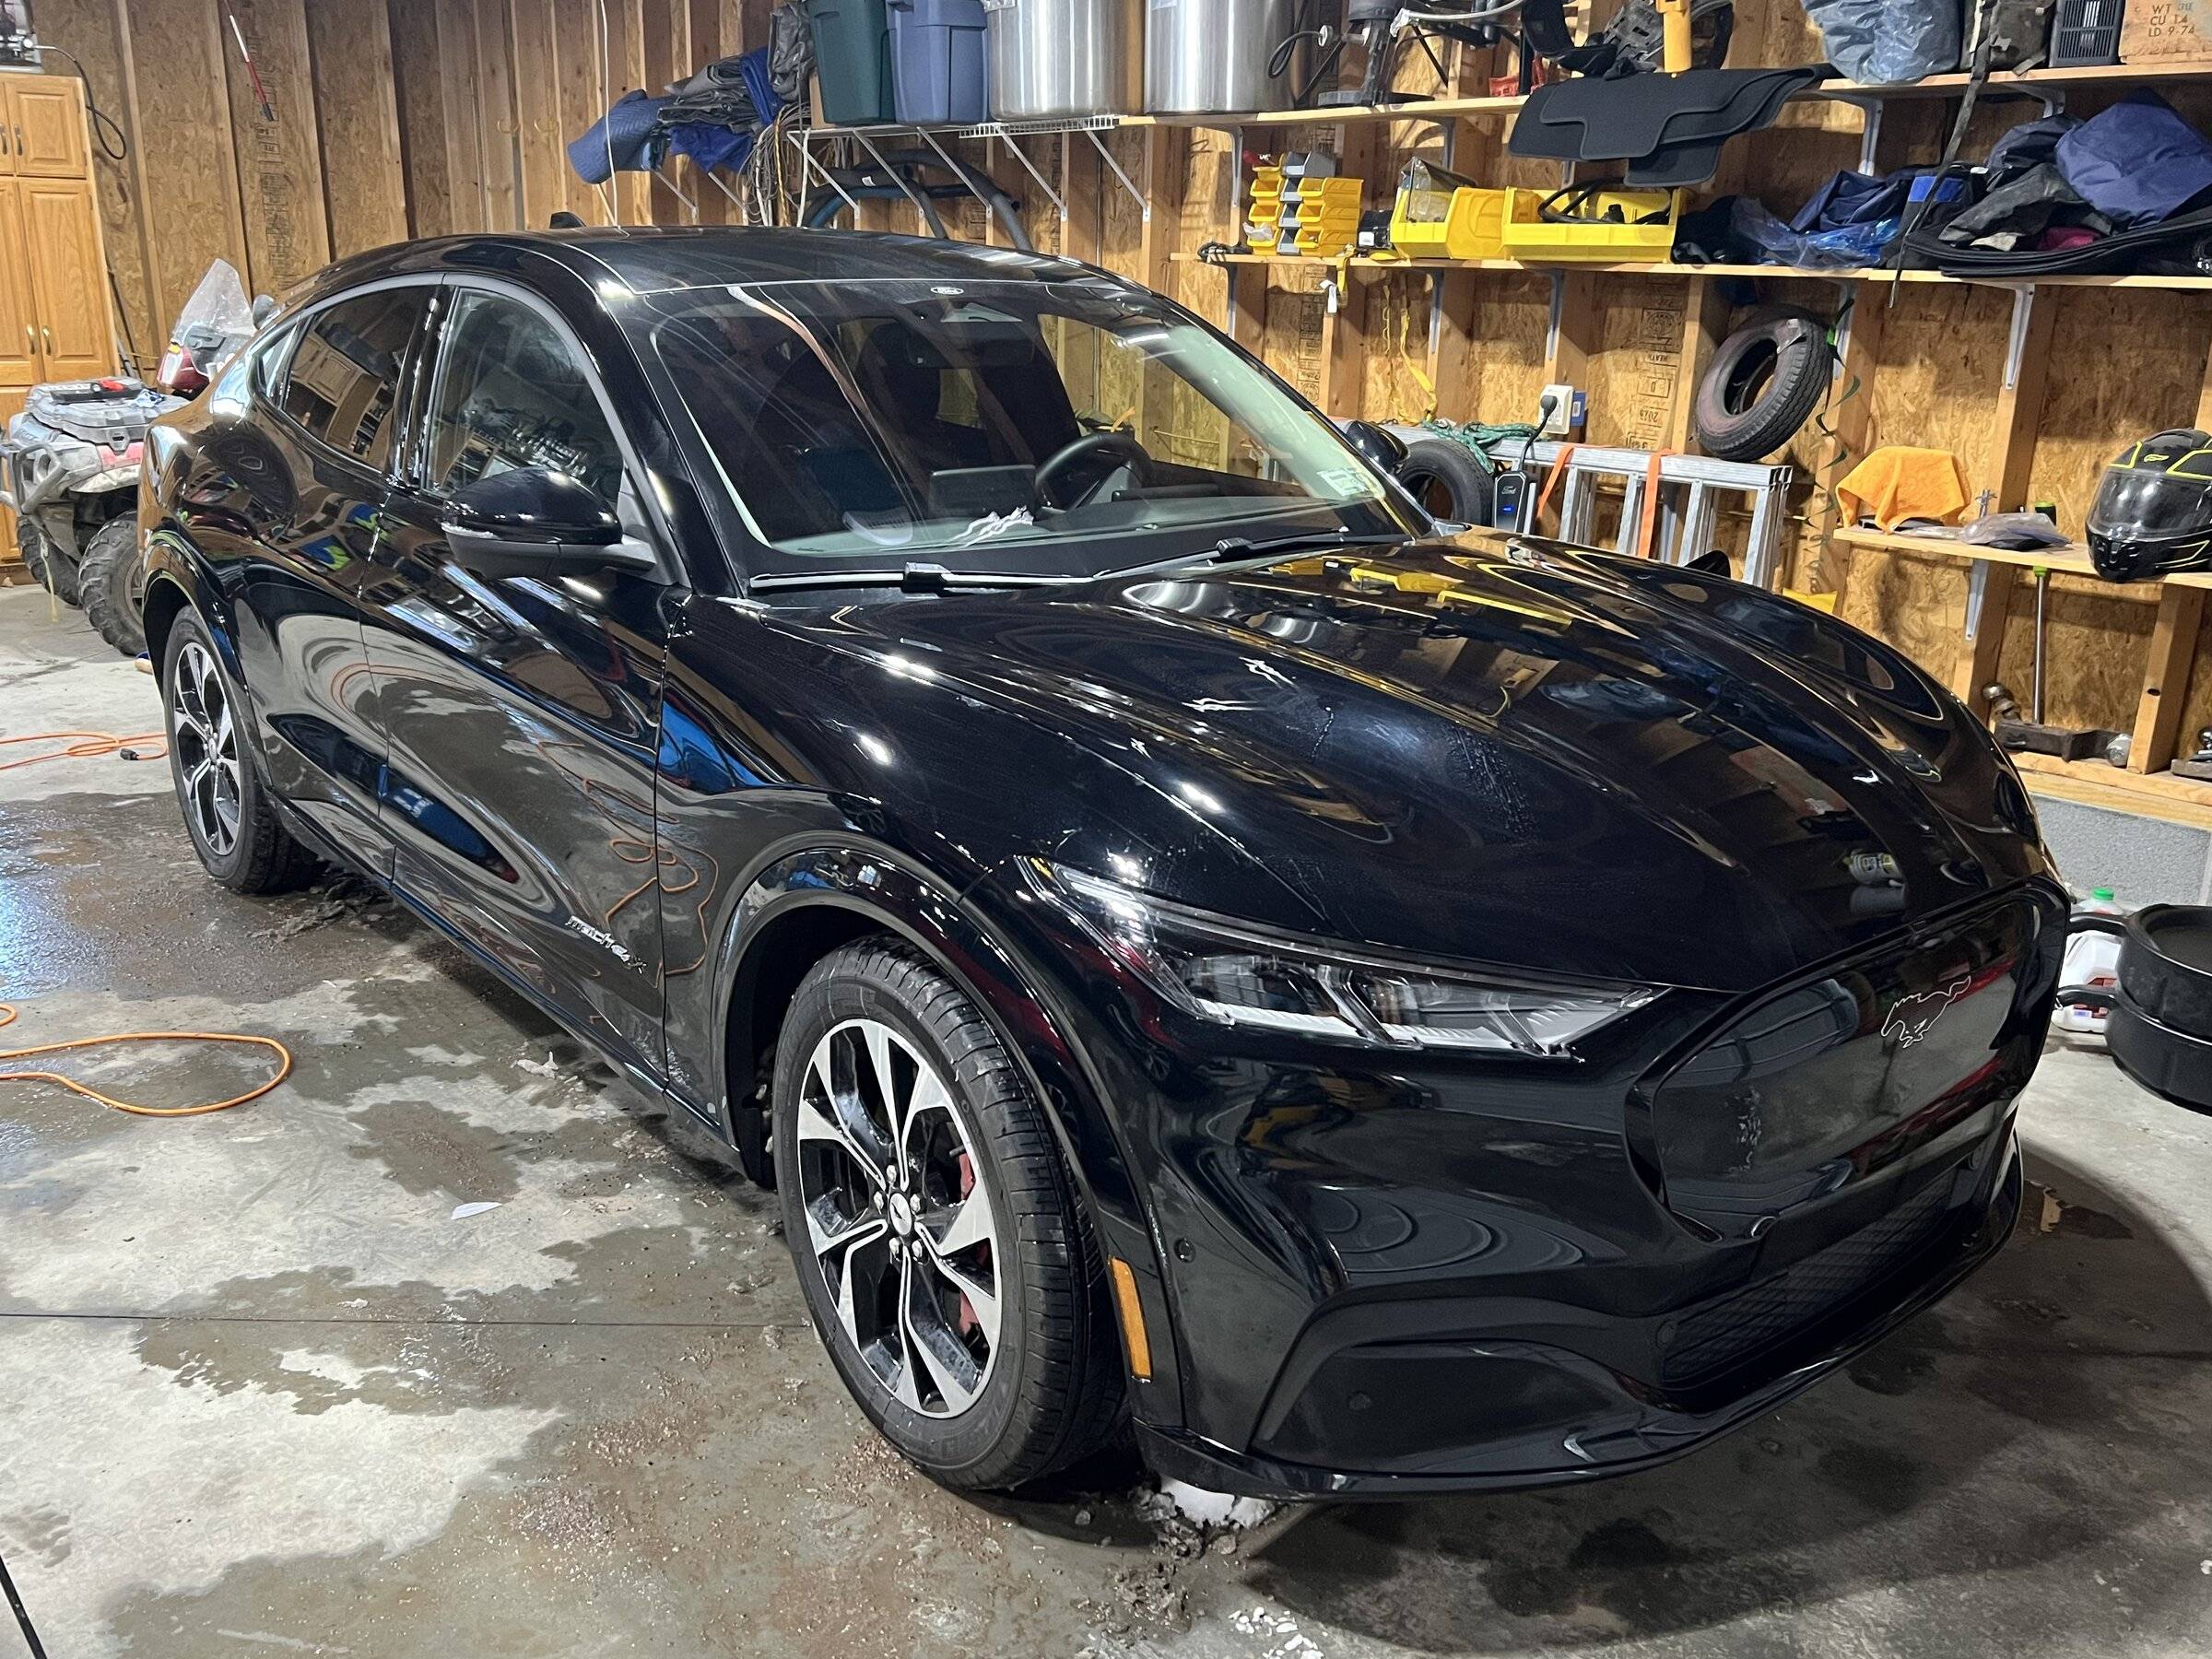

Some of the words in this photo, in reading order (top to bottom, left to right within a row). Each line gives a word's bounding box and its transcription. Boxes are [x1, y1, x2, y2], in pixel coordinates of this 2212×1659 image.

[2151, 3, 2171, 14] WT
[2149, 15, 2166, 25] CU
[2147, 27, 2161, 37] LD
